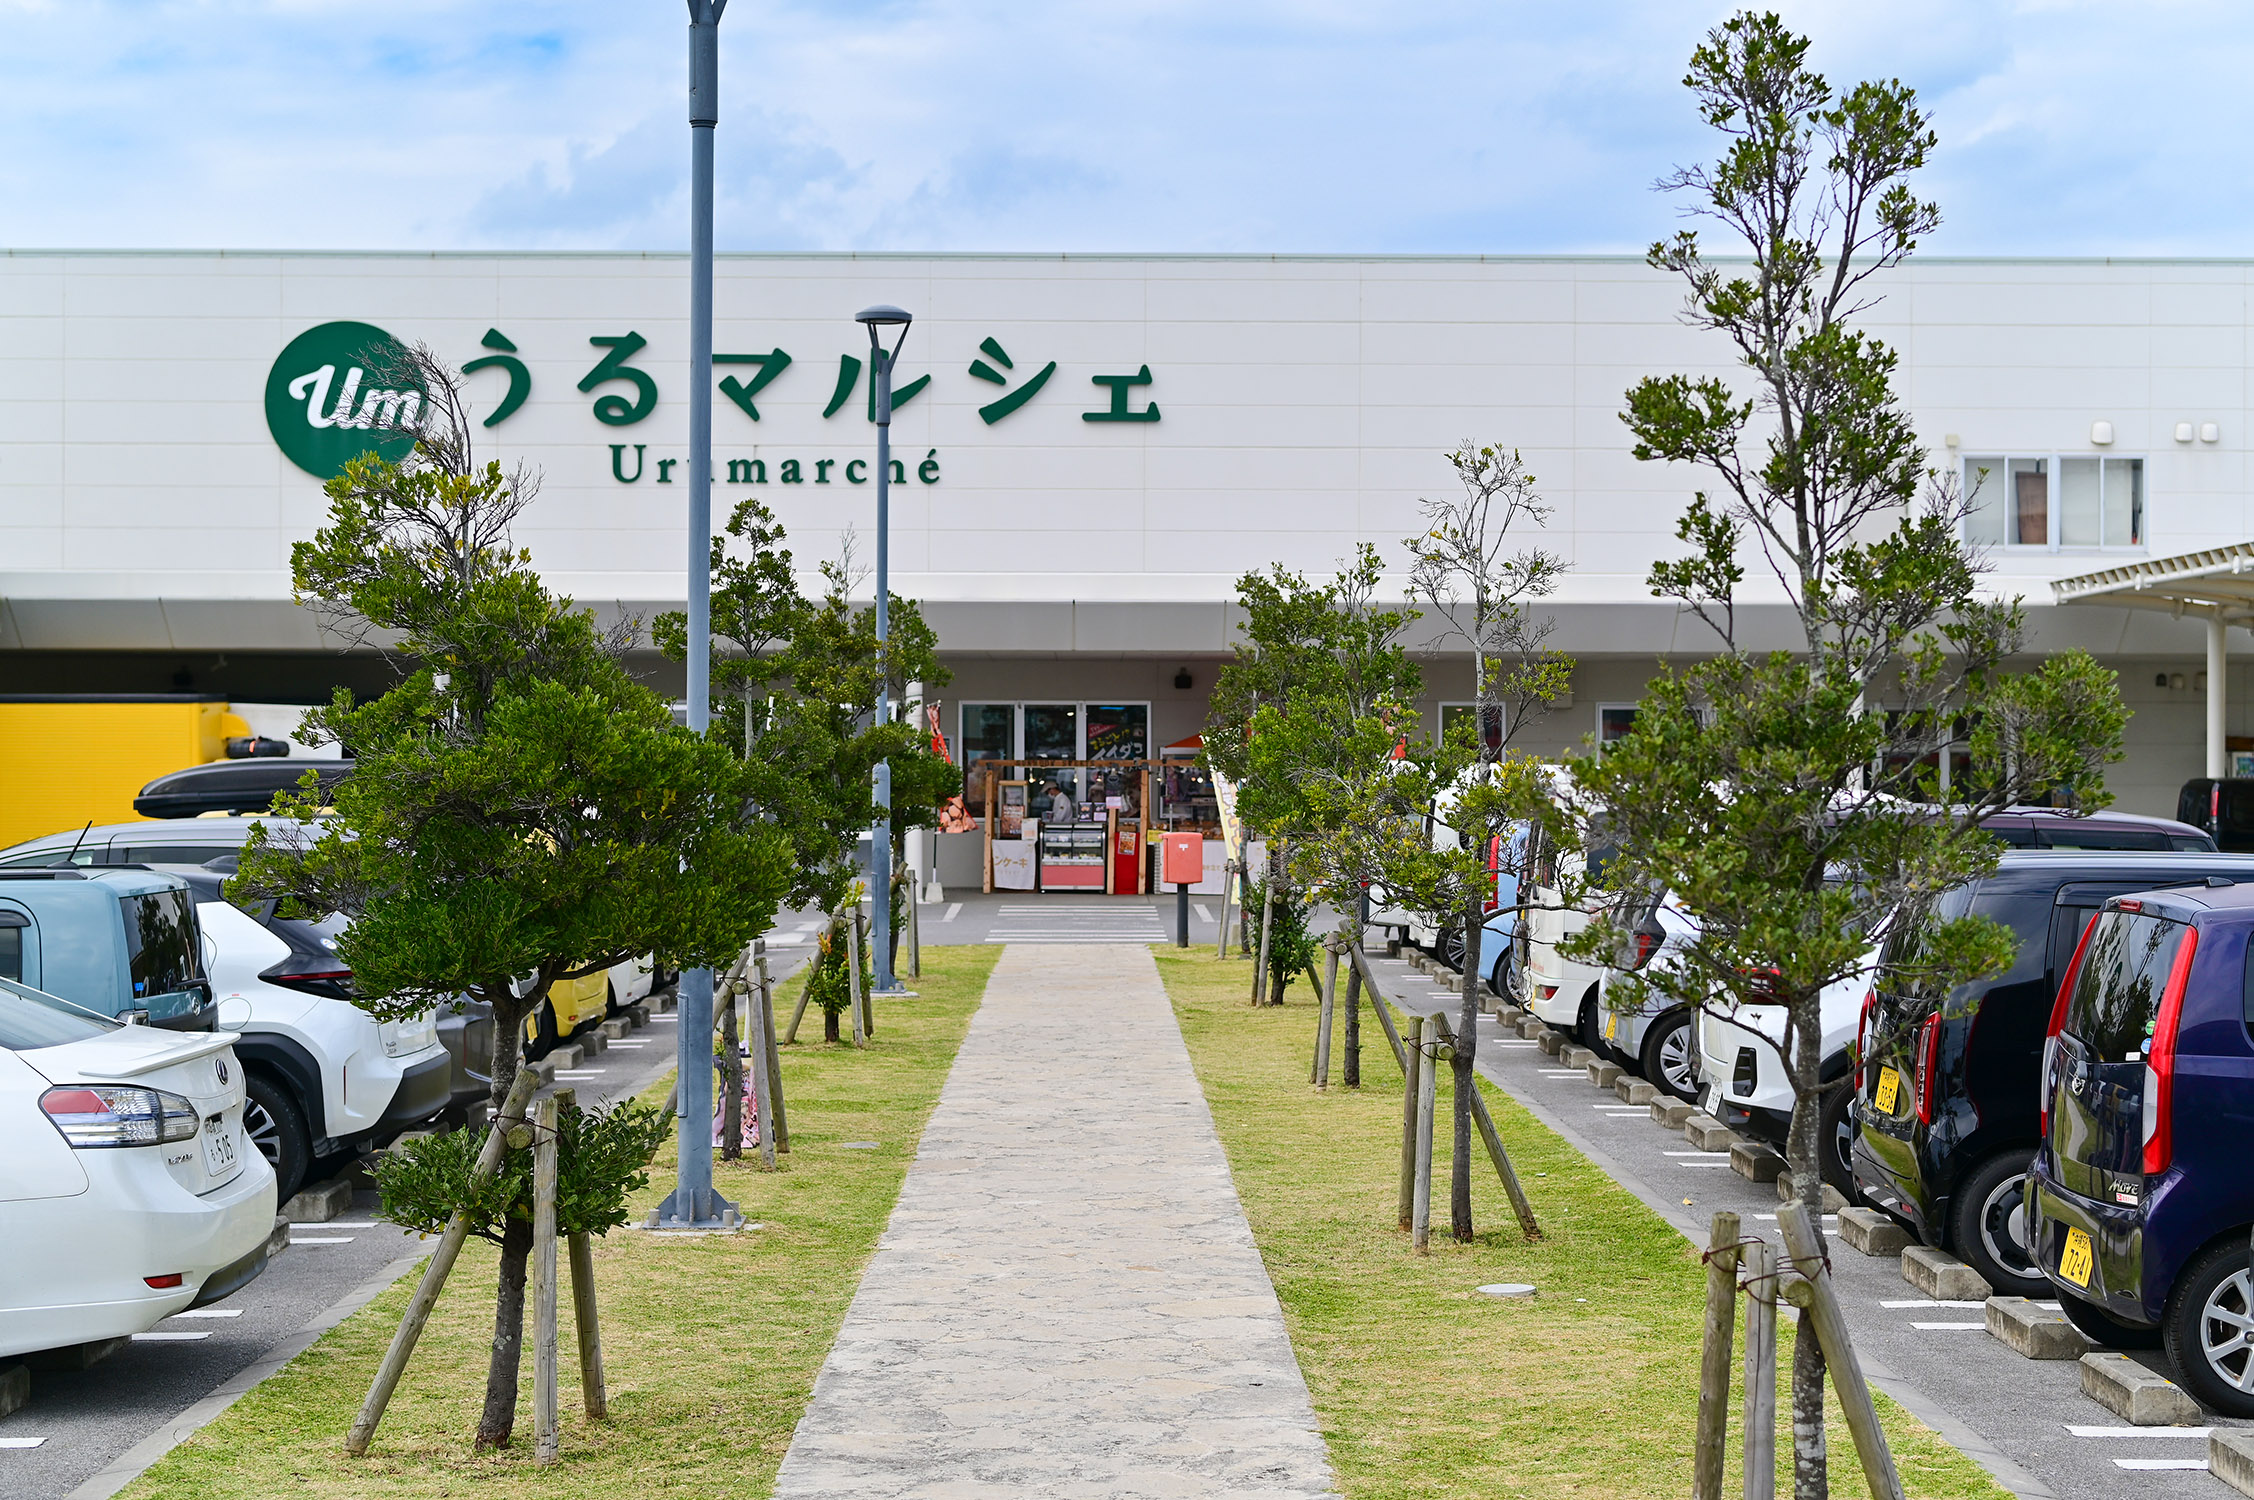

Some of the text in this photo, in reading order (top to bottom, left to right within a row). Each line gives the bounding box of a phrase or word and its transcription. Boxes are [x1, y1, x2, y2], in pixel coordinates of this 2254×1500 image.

[288, 364, 423, 430] Um
[463, 327, 1161, 427] うるマルシェ
[609, 444, 941, 484] Urmarché
